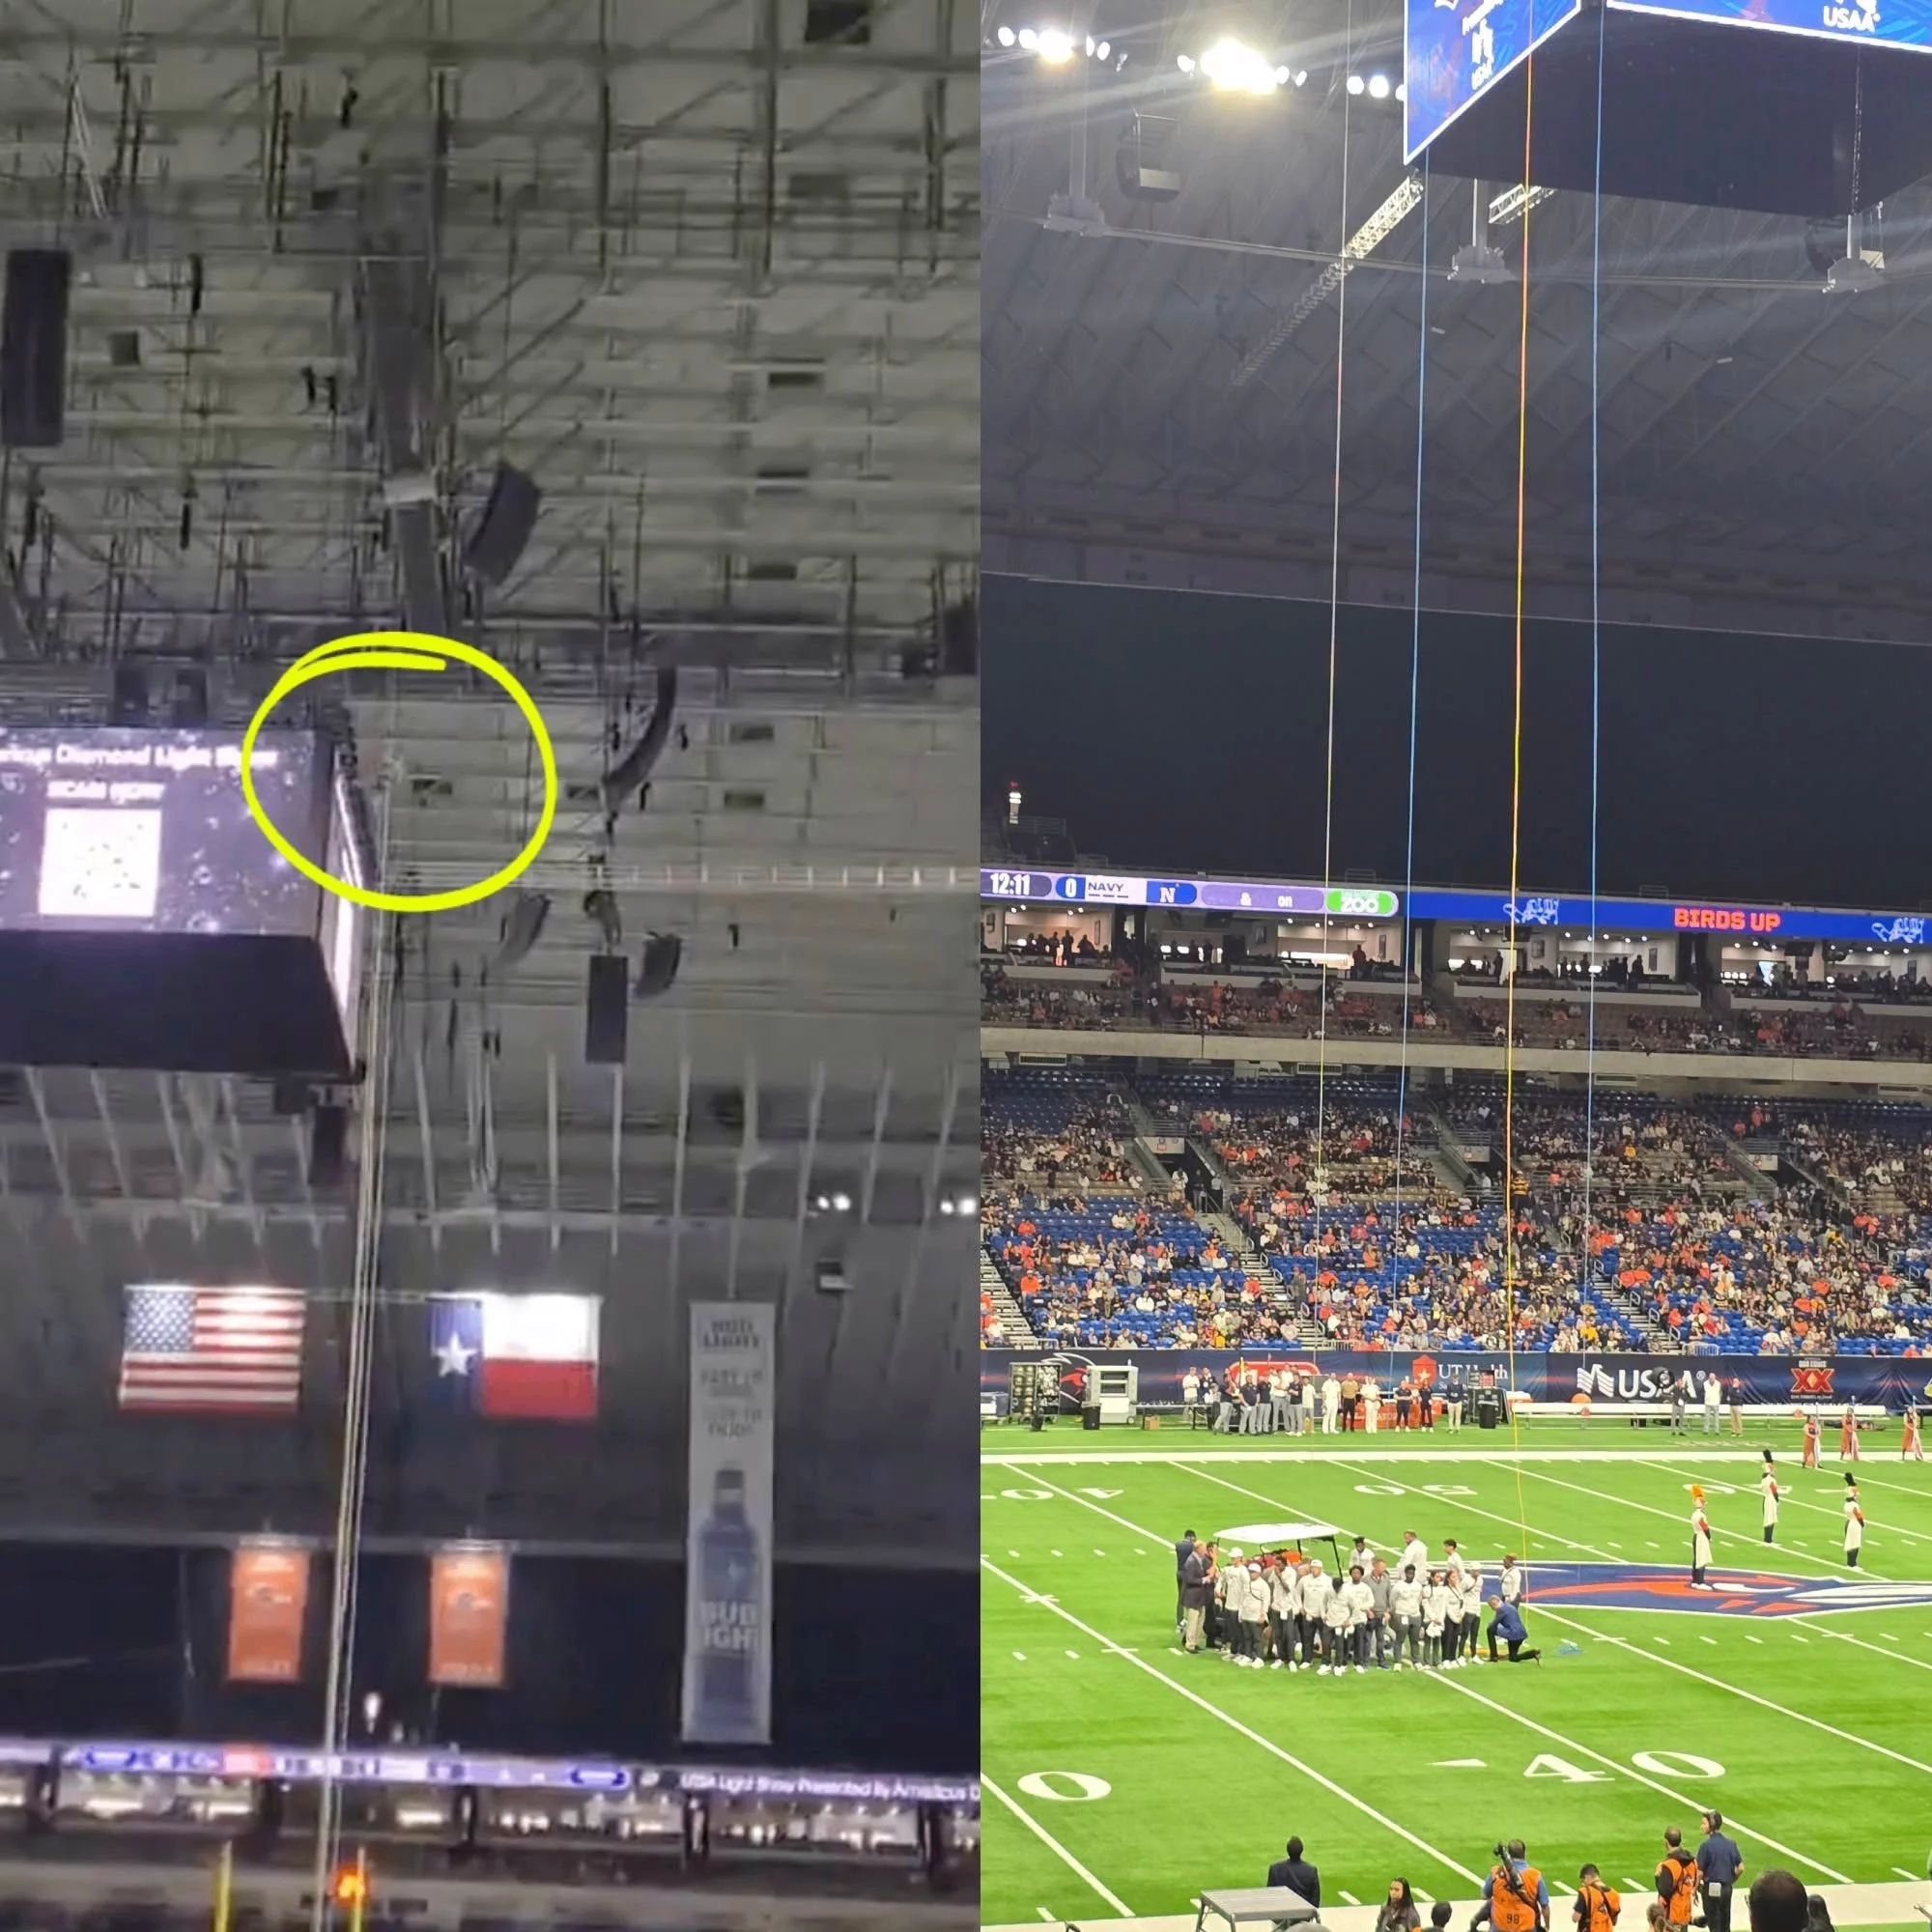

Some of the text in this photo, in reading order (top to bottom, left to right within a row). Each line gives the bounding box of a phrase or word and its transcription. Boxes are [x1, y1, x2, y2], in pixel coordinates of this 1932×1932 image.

[1823, 5, 1877, 33] USAA
[989, 872, 1031, 896] 12:11
[1065, 878, 1077, 898] 0
[1088, 881, 1124, 894] NAVY
[1240, 892, 1252, 906] &
[1277, 895, 1293, 908] on
[1674, 908, 1781, 932] BIRDS UP
[1618, 1369, 1697, 1399] USA
[1790, 1368, 1835, 1393] XX
[1506, 1913, 1520, 1924] 98
